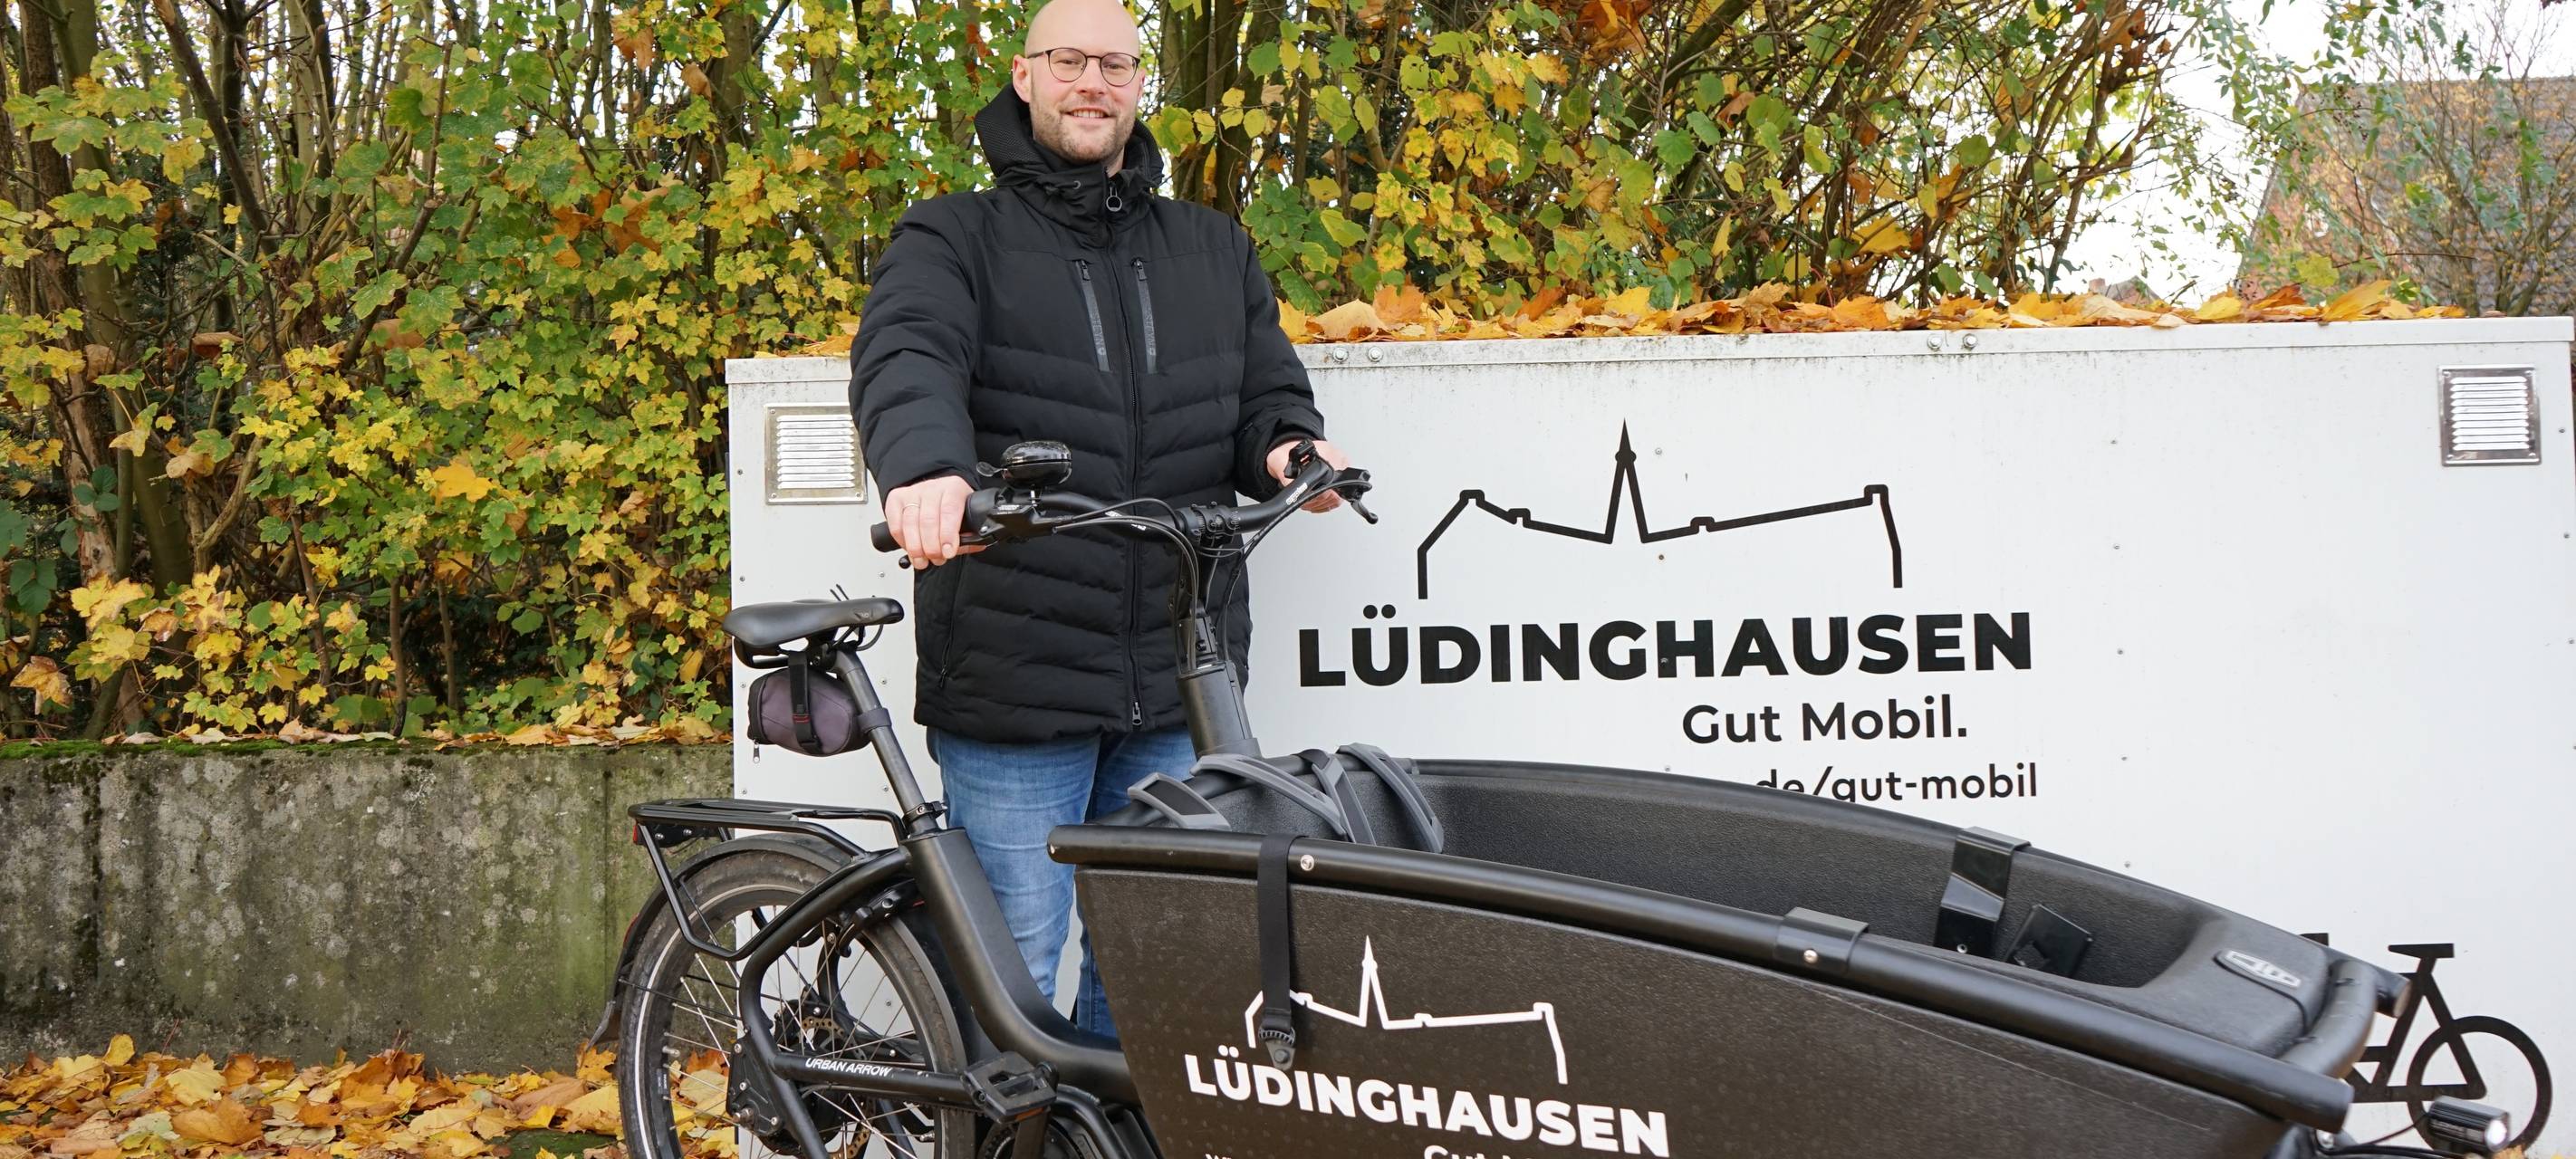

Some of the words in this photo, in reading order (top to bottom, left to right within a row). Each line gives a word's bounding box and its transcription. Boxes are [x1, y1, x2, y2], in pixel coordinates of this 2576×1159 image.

[1299, 605, 2031, 686] LÜDINGHAUSEN
[1682, 704, 1783, 743] Gut
[1802, 694, 1967, 741] Mobil.
[805, 1058, 847, 1071] URBAN
[845, 1063, 892, 1077] ARROW
[1184, 1044, 1670, 1158] LÜDINGHAUSEN
